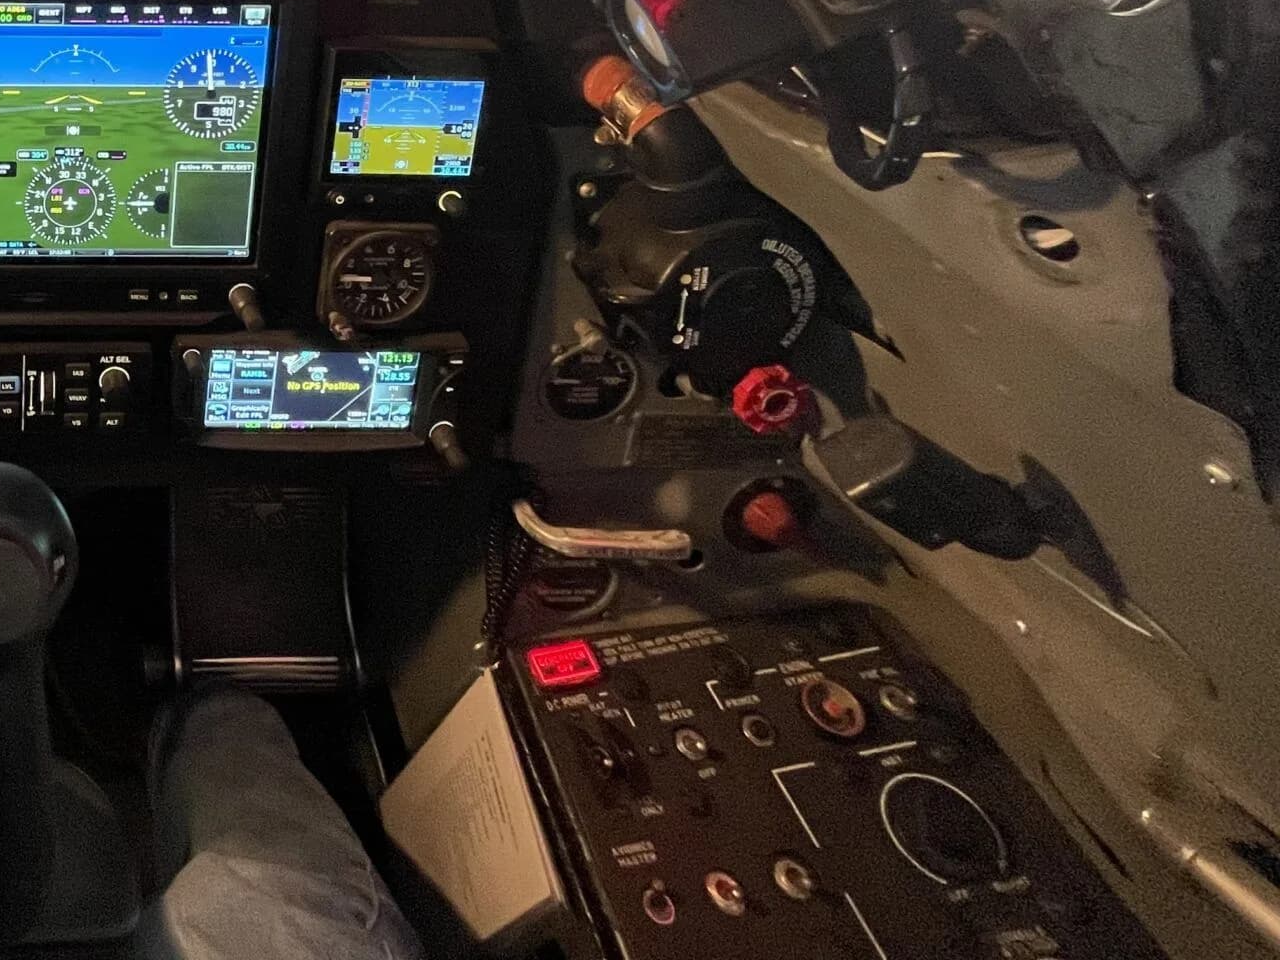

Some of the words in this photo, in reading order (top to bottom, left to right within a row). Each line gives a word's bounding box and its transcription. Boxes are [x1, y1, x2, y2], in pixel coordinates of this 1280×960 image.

[211, 106, 234, 117] 980
[451, 125, 463, 134] 10
[58, 171, 70, 179] 30
[75, 171, 87, 180] 33
[54, 227, 66, 235] 15
[71, 228, 82, 236] 12
[386, 243, 396, 255] 6
[99, 355, 115, 364] ALT
[116, 356, 133, 364] SEL
[382, 353, 414, 363] 121.15
[286, 381, 301, 391] No
[302, 381, 321, 391] GPS
[322, 381, 360, 392] Position
[250, 411, 264, 419] FPL
